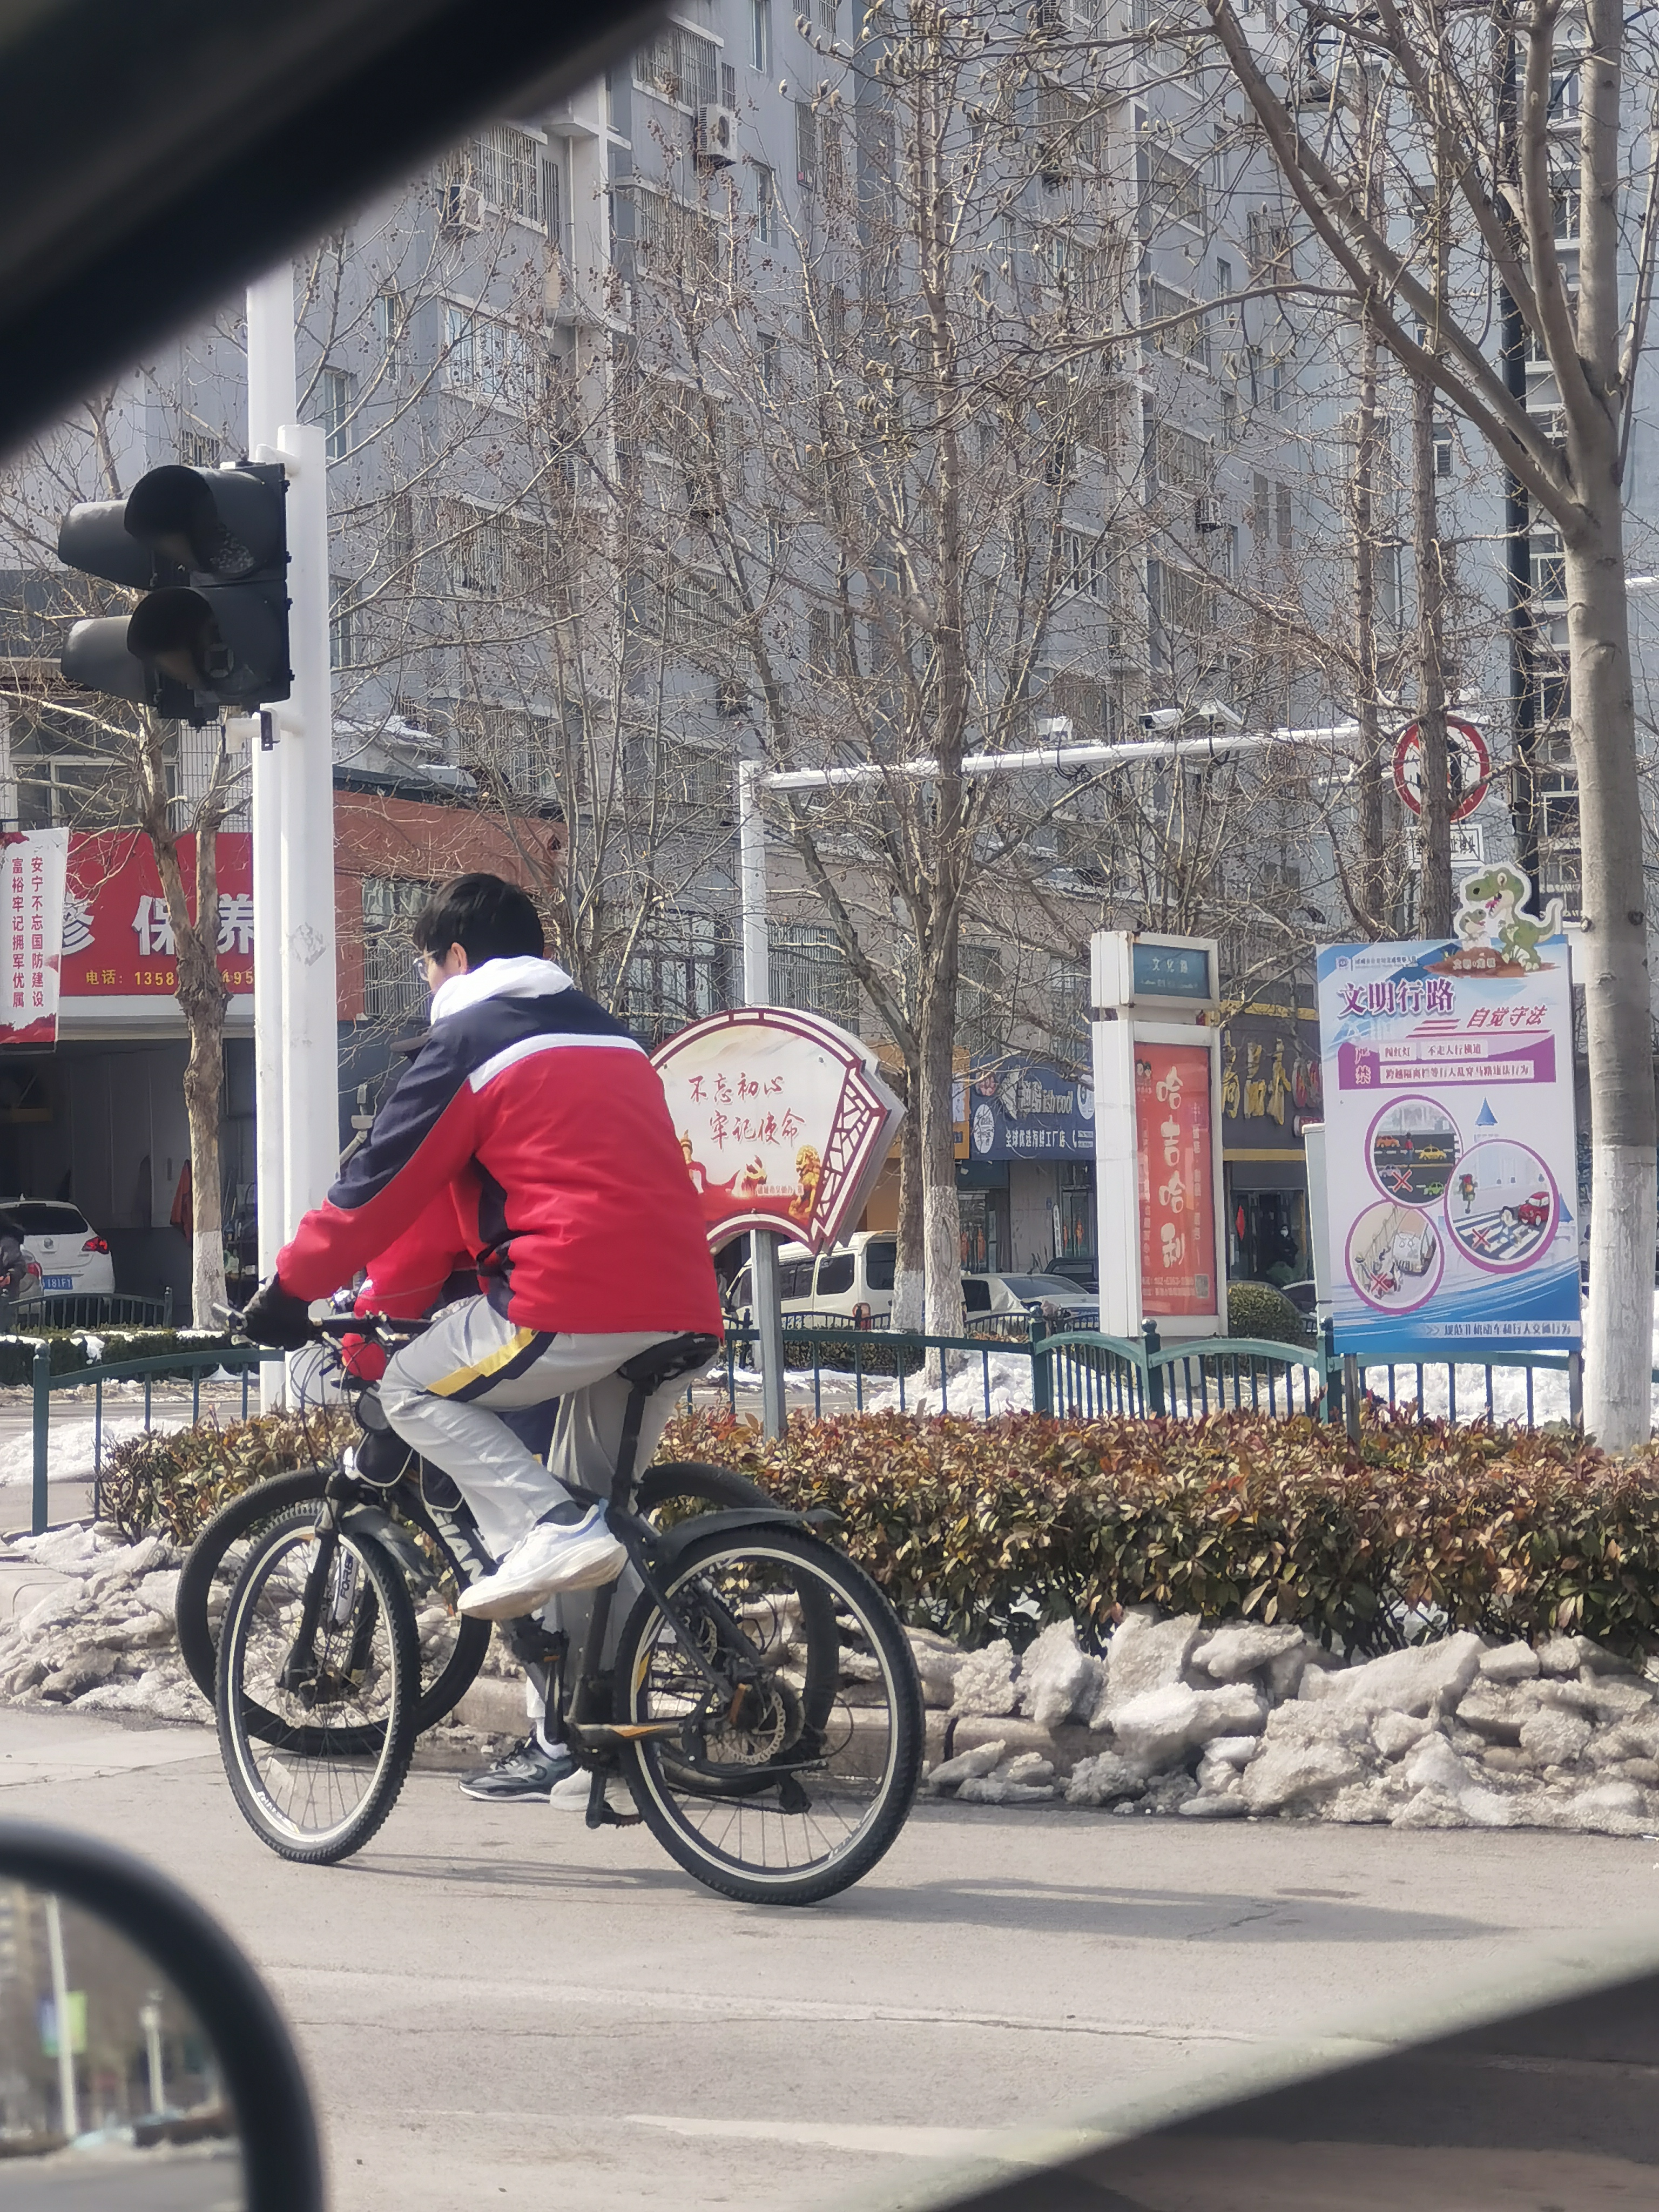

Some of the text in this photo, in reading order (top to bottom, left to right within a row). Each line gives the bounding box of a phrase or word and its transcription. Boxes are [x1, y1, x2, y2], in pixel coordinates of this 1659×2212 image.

[11, 857, 24, 1008] 富裕牢记拥军优属
[31, 856, 44, 1007] 安宁不忘国防建设
[1338, 979, 1454, 1017] 文明行路
[1466, 1005, 1548, 1028] 自觉守法
[687, 1072, 784, 1104] 不忘初心
[709, 1108, 806, 1150] 牢记使命
